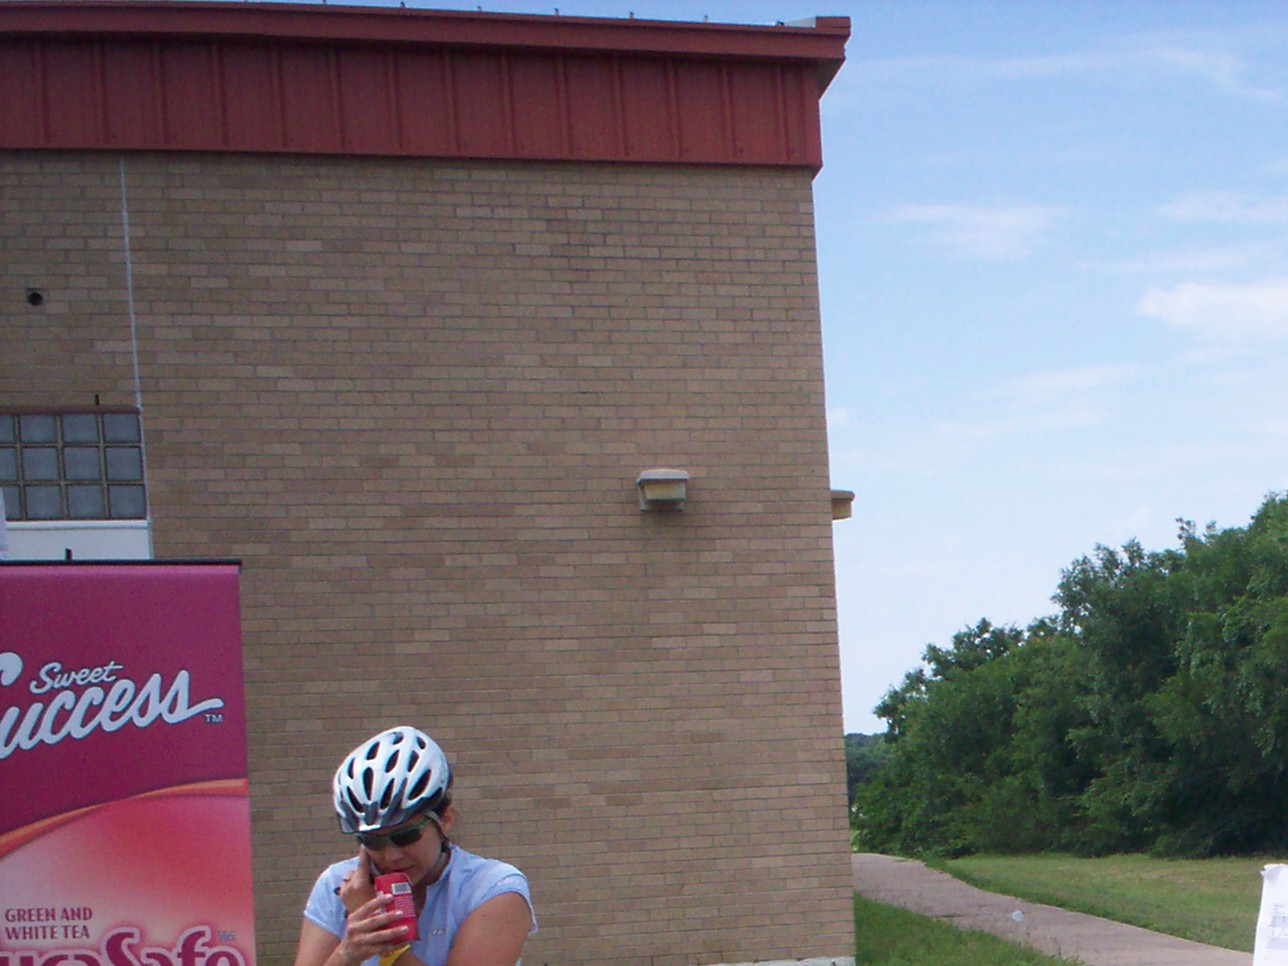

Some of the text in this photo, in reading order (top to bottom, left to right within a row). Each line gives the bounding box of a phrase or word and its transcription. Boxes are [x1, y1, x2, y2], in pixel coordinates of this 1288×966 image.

[30, 661, 123, 693] Sweet
[0, 652, 224, 759] uccess
[5, 907, 92, 922] GREEN AND
[5, 925, 90, 940] WHITE TEA
